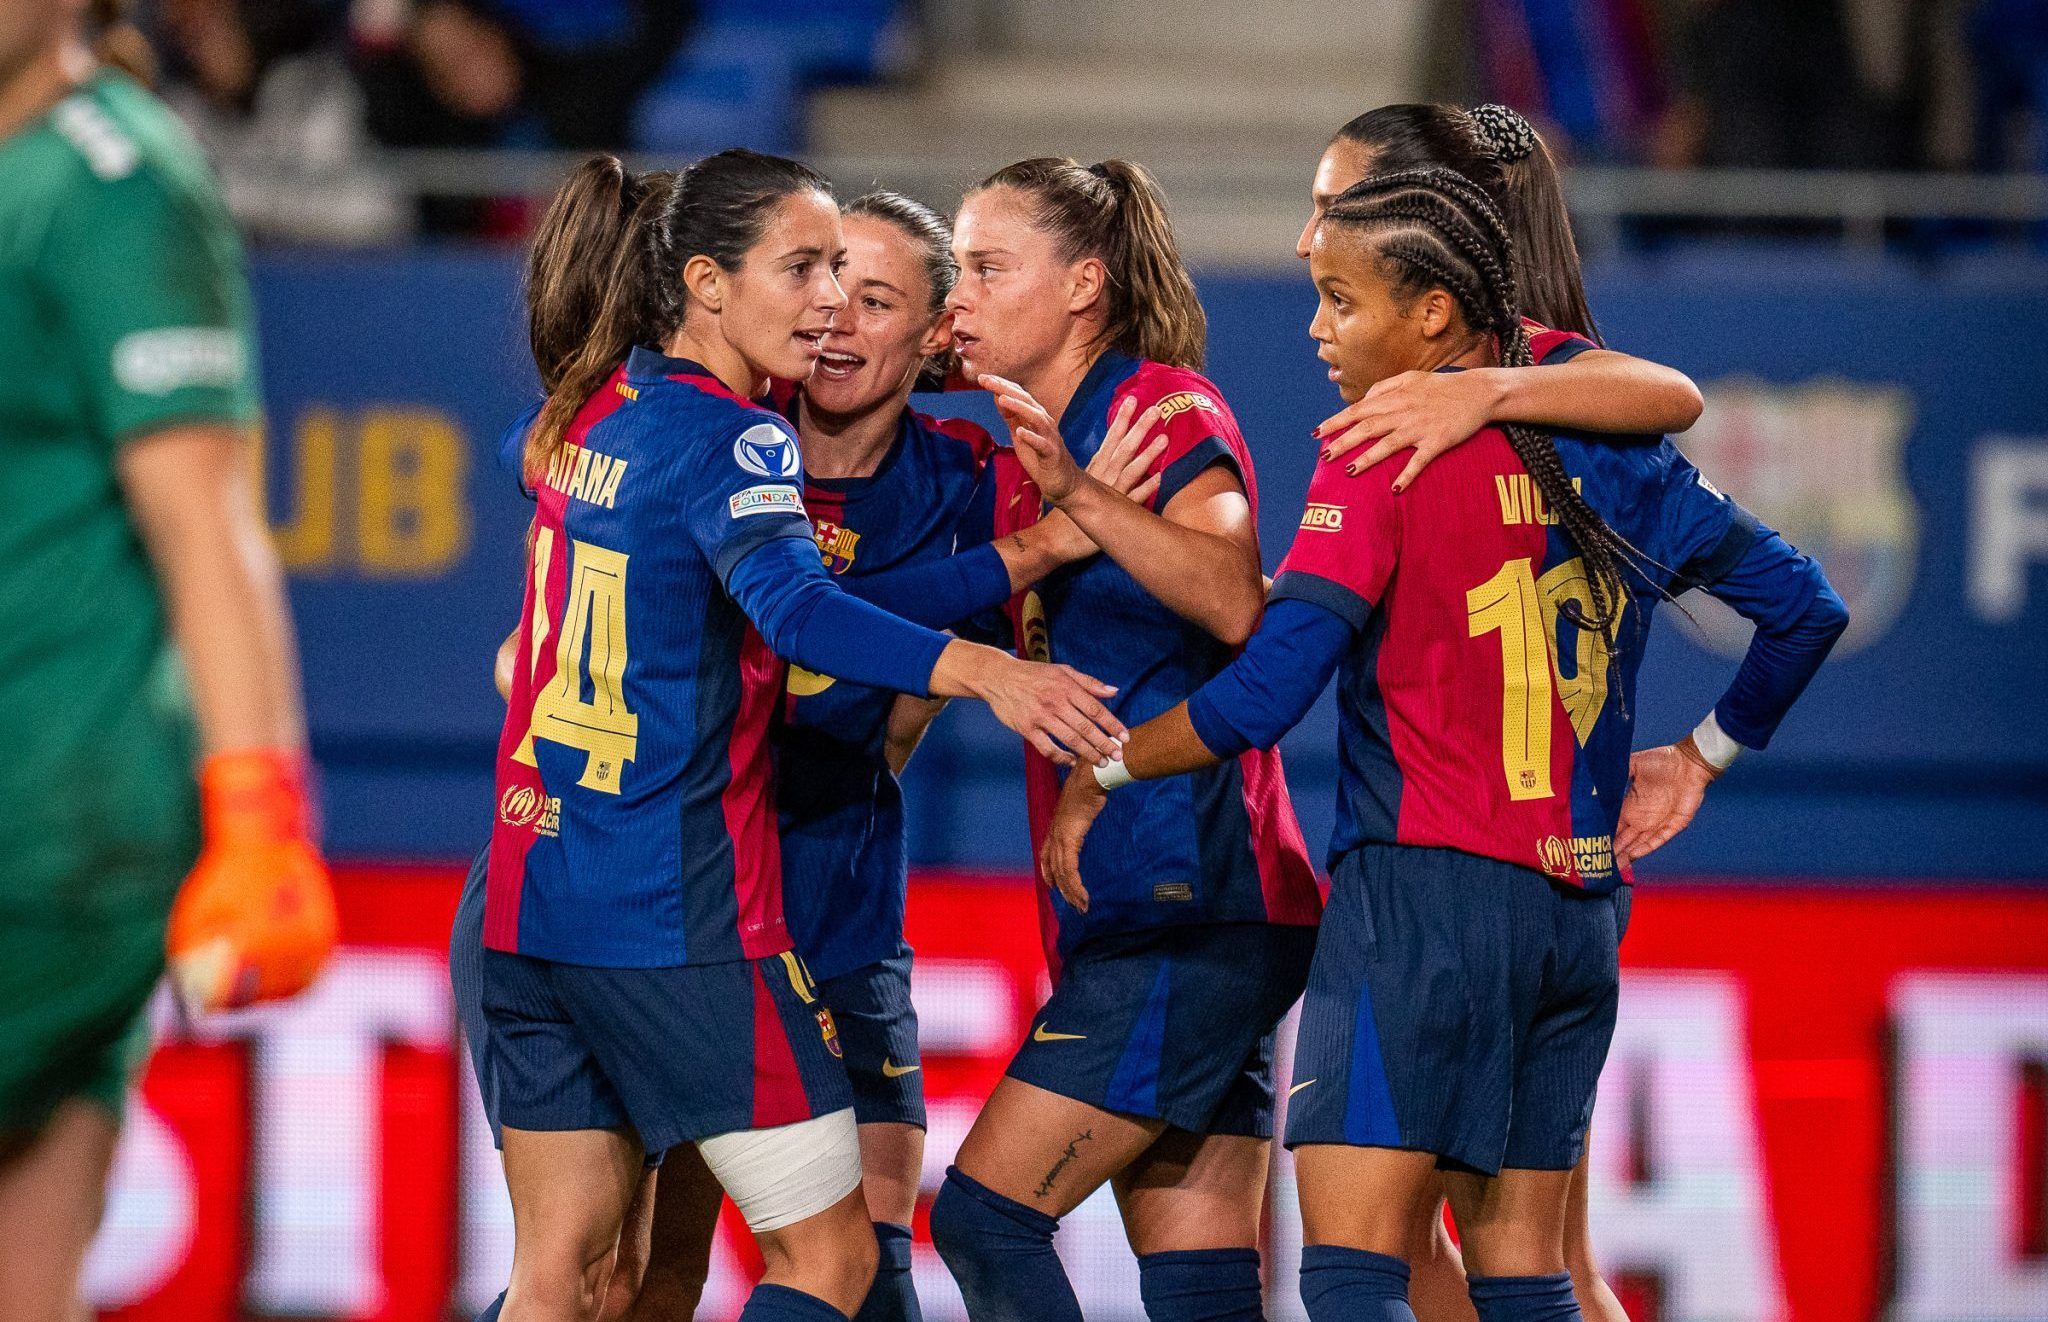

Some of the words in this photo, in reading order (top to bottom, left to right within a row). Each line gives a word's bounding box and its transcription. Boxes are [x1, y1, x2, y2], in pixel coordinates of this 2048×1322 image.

[546, 441, 628, 510] AITANA
[732, 493, 798, 510] FOUNDAT
[510, 526, 638, 796] 14
[1466, 557, 1629, 801] 19
[1574, 852, 1613, 872] ACNUR
